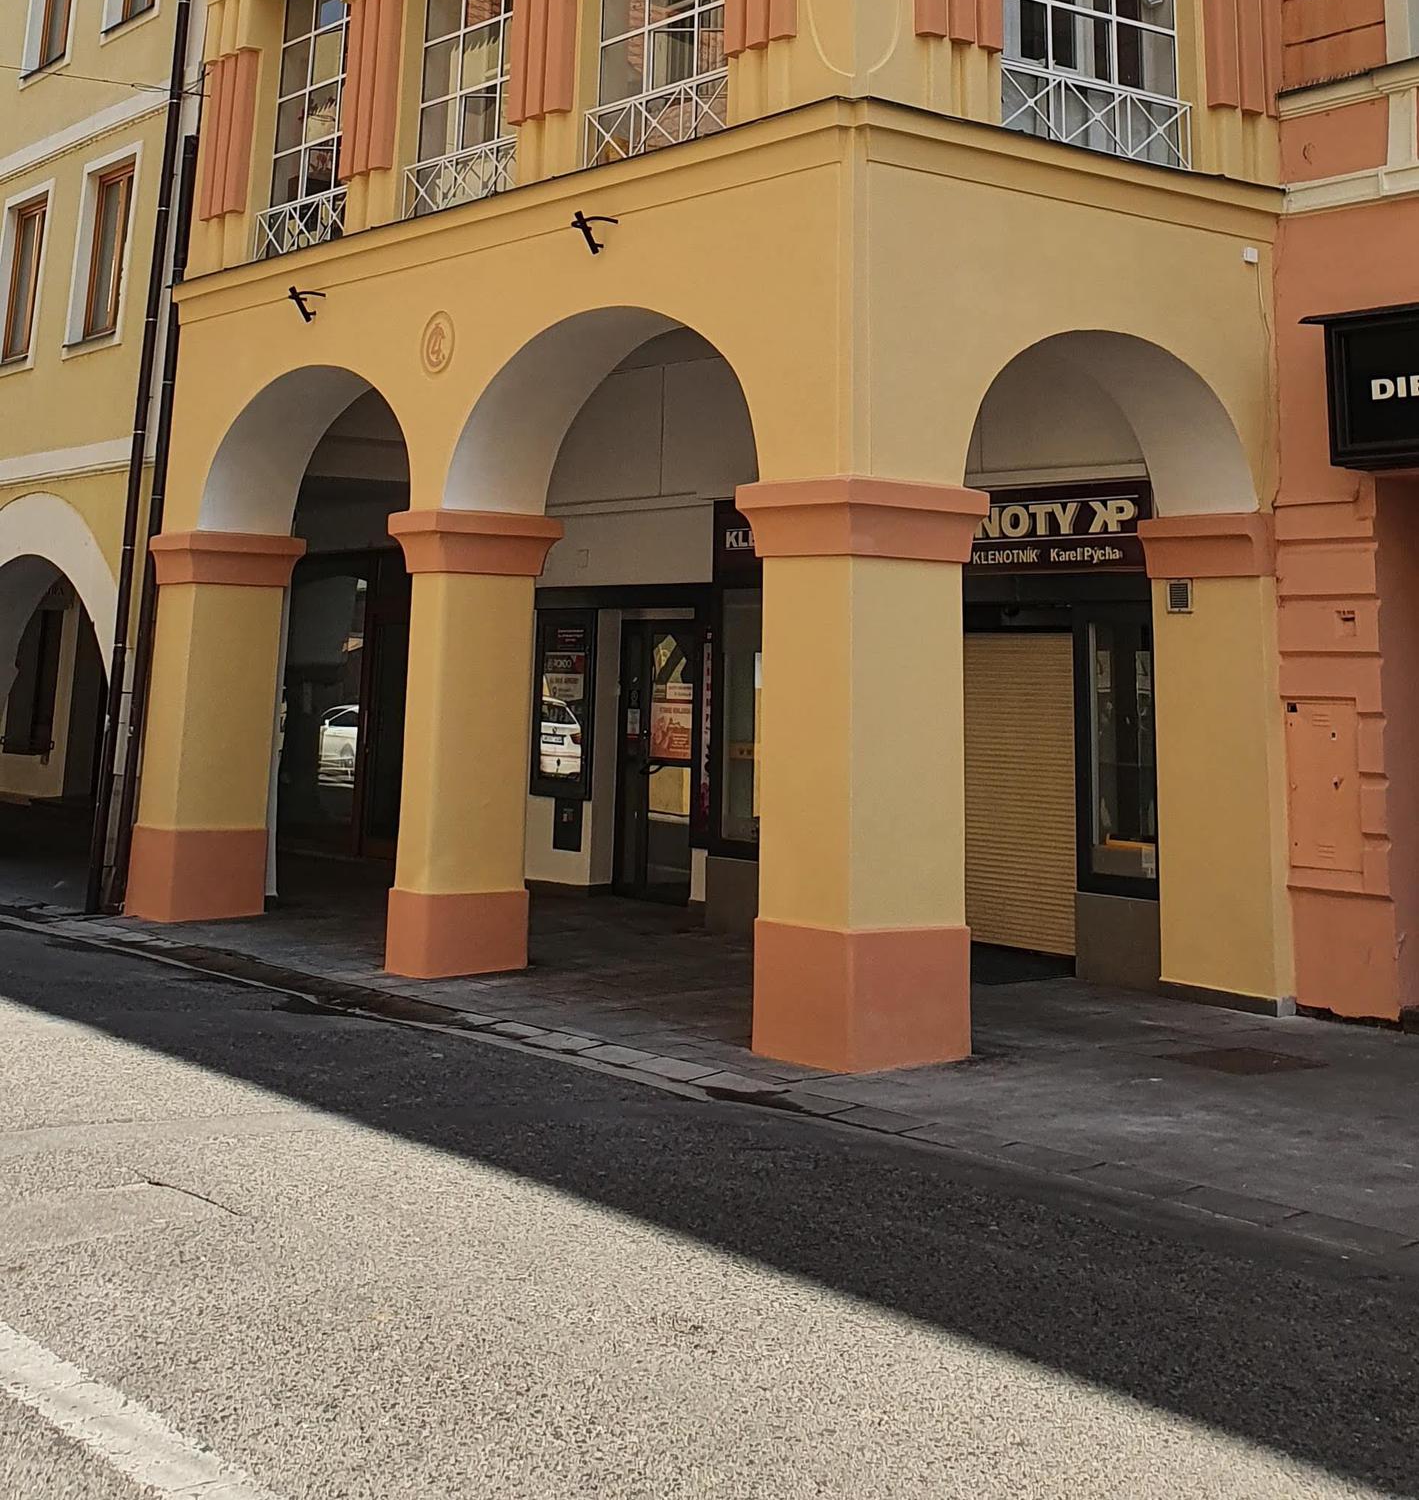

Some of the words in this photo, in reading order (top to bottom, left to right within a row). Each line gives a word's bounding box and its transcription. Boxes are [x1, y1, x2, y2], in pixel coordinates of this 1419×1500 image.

[974, 502, 1079, 538] NOTY
[972, 546, 1039, 564] KLENOTNÍK
[1050, 547, 1081, 562] Karel
[1084, 546, 1120, 564] Pýcha
